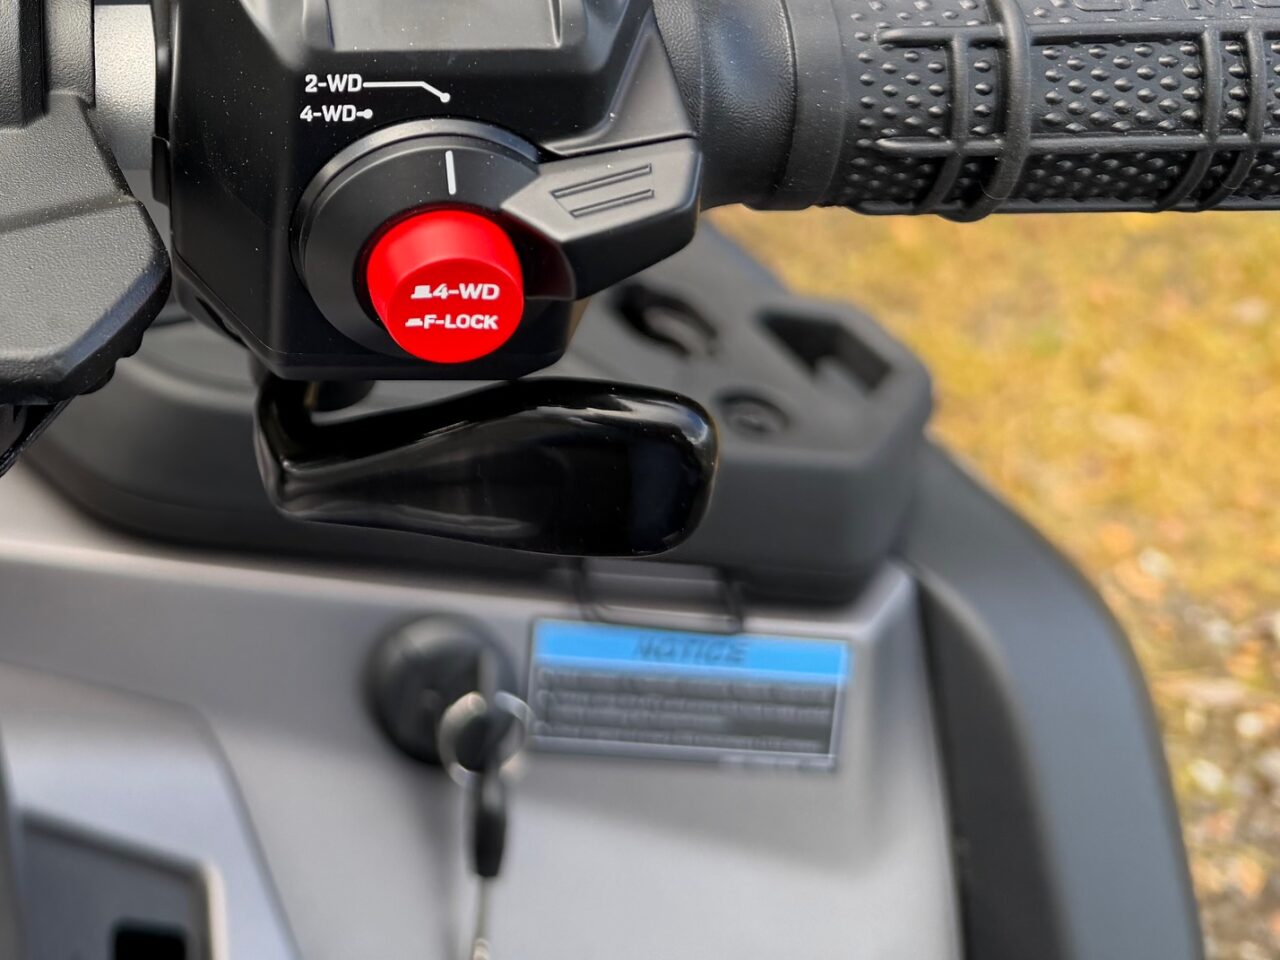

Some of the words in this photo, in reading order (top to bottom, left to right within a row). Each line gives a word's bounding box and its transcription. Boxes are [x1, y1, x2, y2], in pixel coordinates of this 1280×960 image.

[305, 73, 363, 93] 2-WD
[299, 104, 357, 122] 4-WD
[432, 283, 500, 300] 4-WD
[423, 313, 499, 330] F-LOCK
[630, 633, 750, 665] NOTICE
